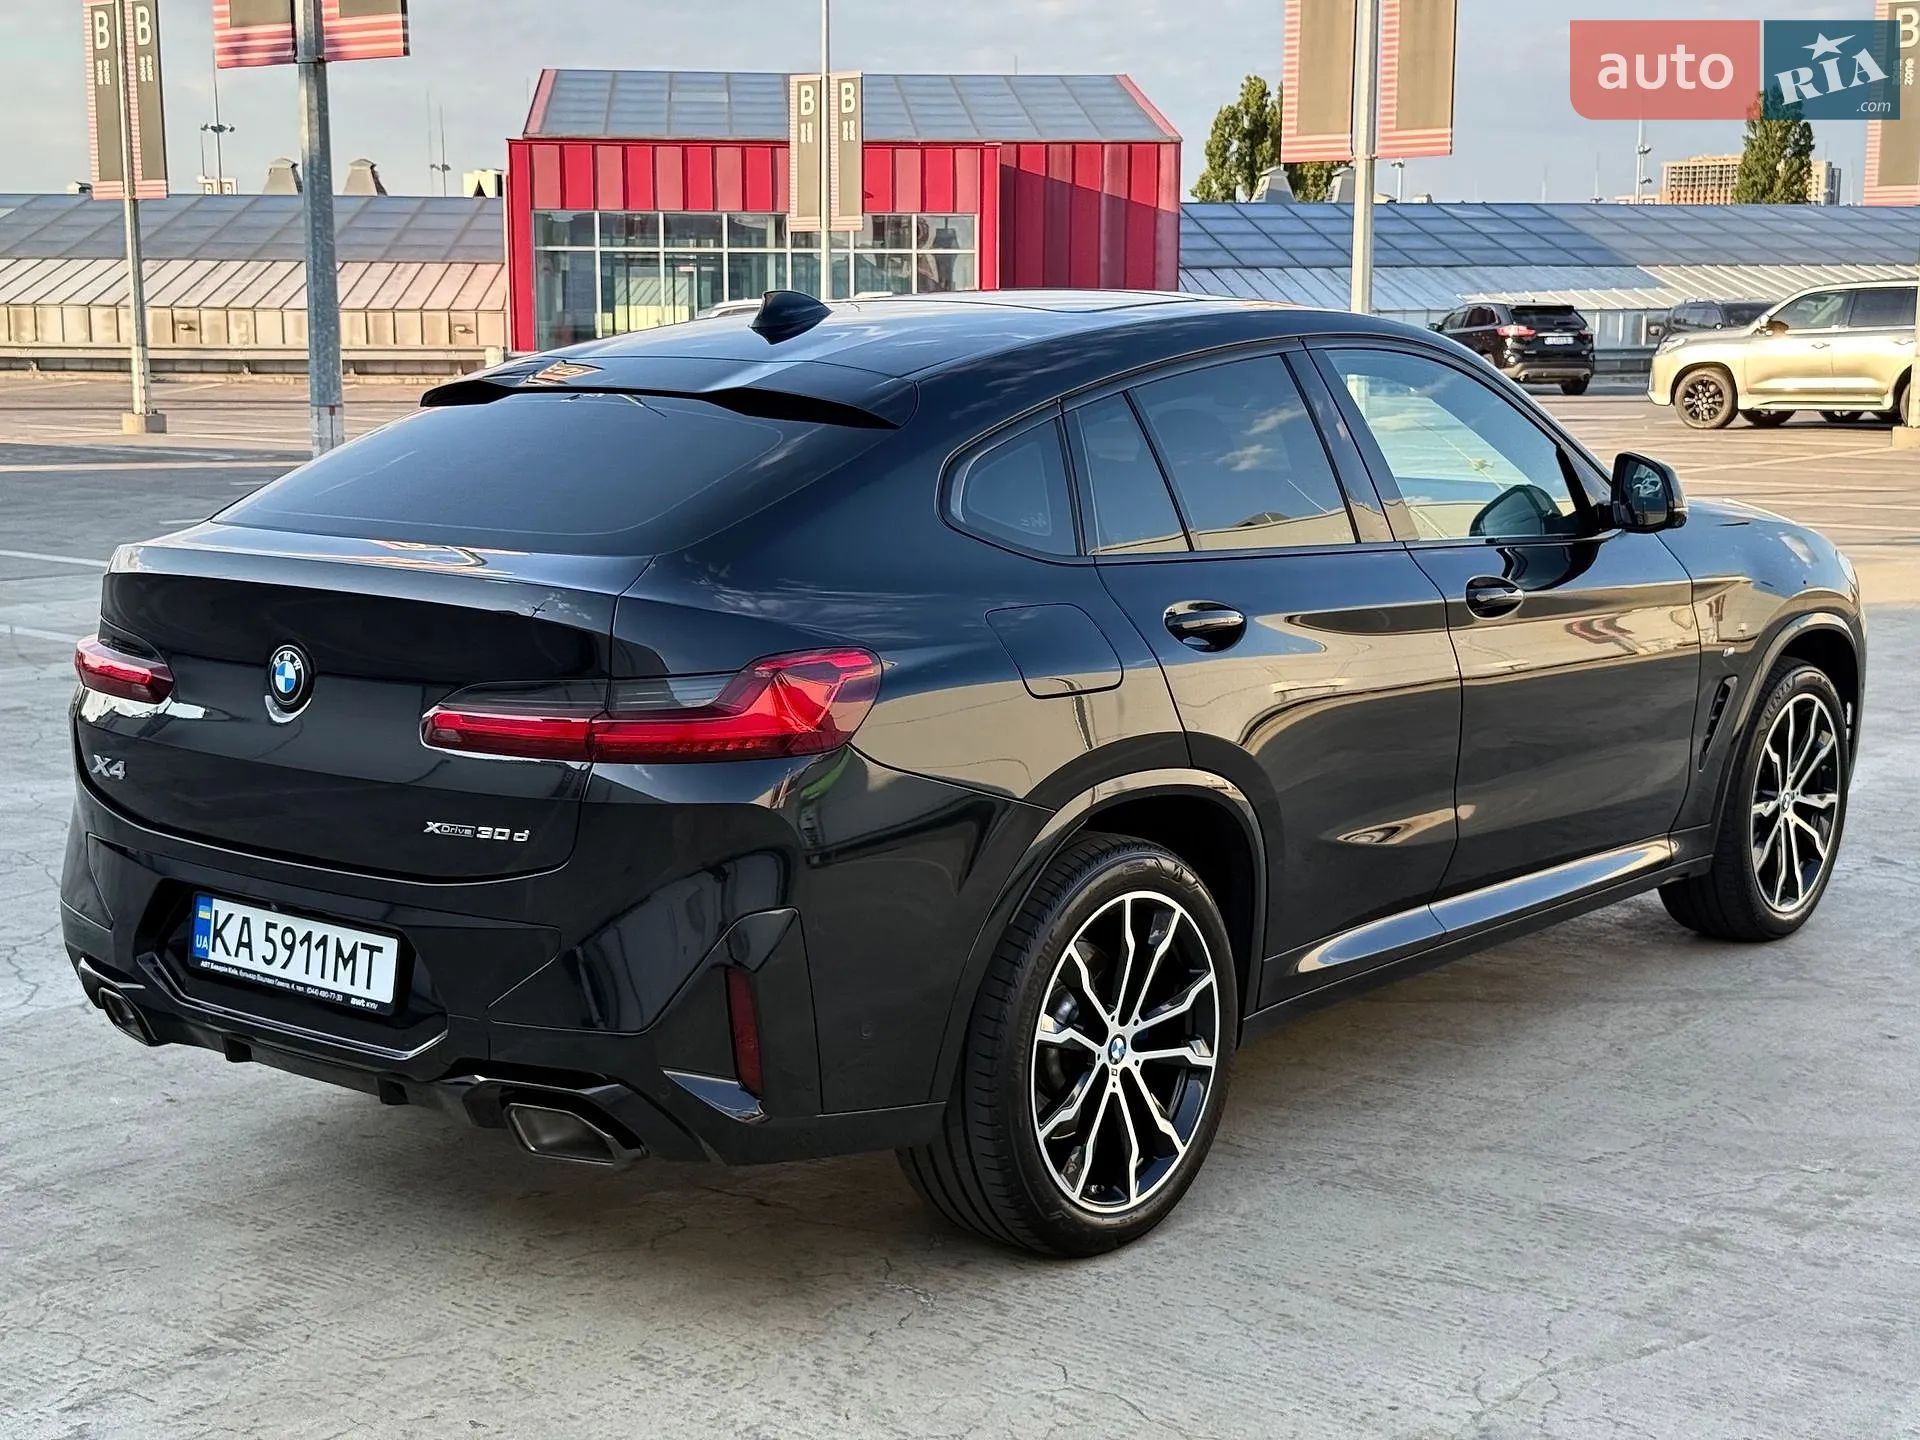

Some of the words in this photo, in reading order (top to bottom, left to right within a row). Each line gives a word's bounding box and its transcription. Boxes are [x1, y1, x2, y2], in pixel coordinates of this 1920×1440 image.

[94, 9, 111, 50] B
[134, 5, 152, 46] B
[1895, 7, 1919, 48] B
[800, 85, 815, 116] B
[841, 82, 856, 113] B
[91, 754, 126, 780] X4
[195, 934, 209, 951] UA
